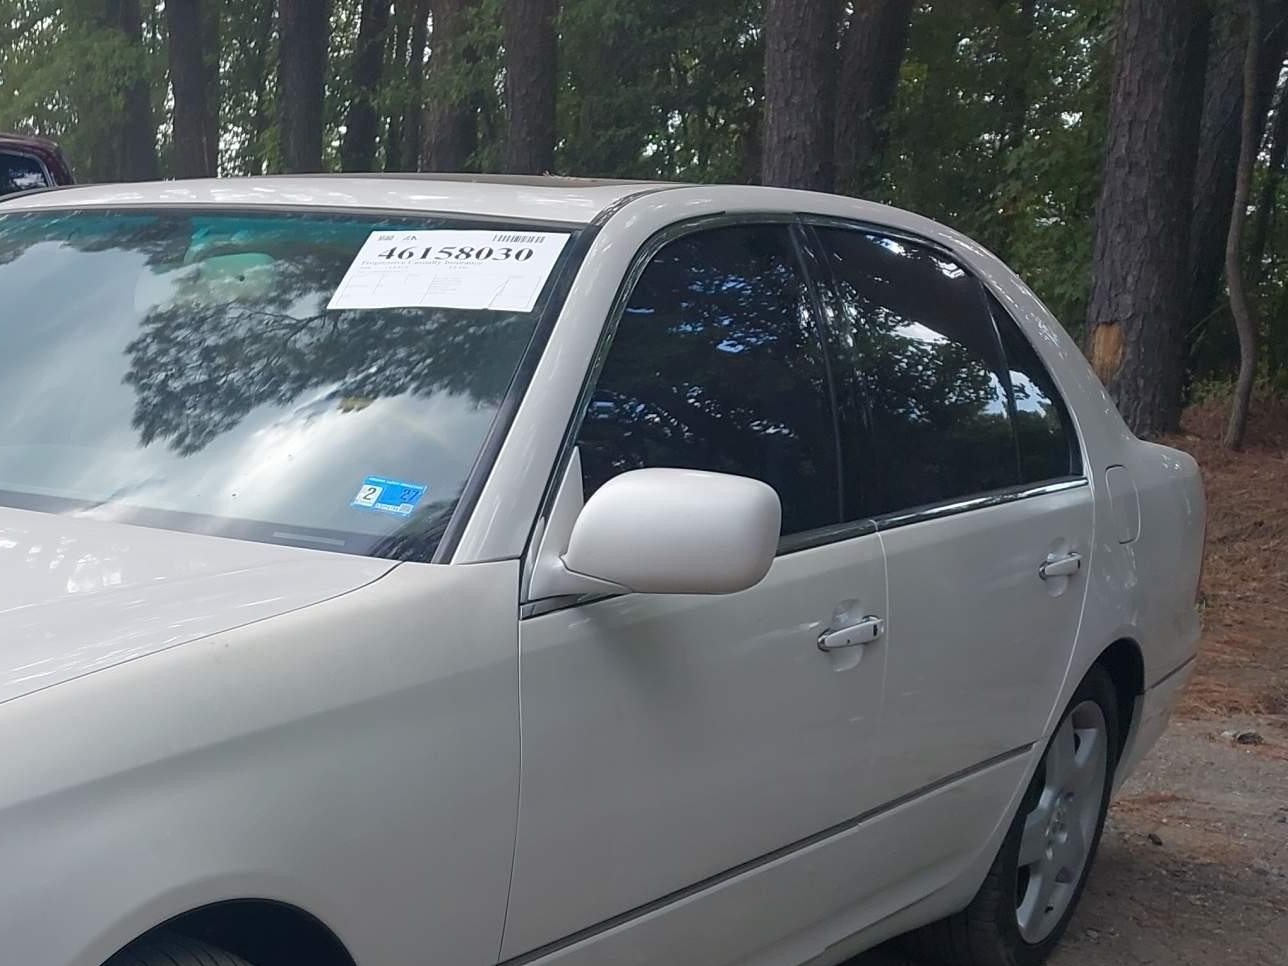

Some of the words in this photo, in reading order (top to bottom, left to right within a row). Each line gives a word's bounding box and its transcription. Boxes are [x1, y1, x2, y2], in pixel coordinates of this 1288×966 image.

[378, 246, 533, 261] 46158030
[362, 487, 377, 500] 2
[400, 488, 419, 501] 27
